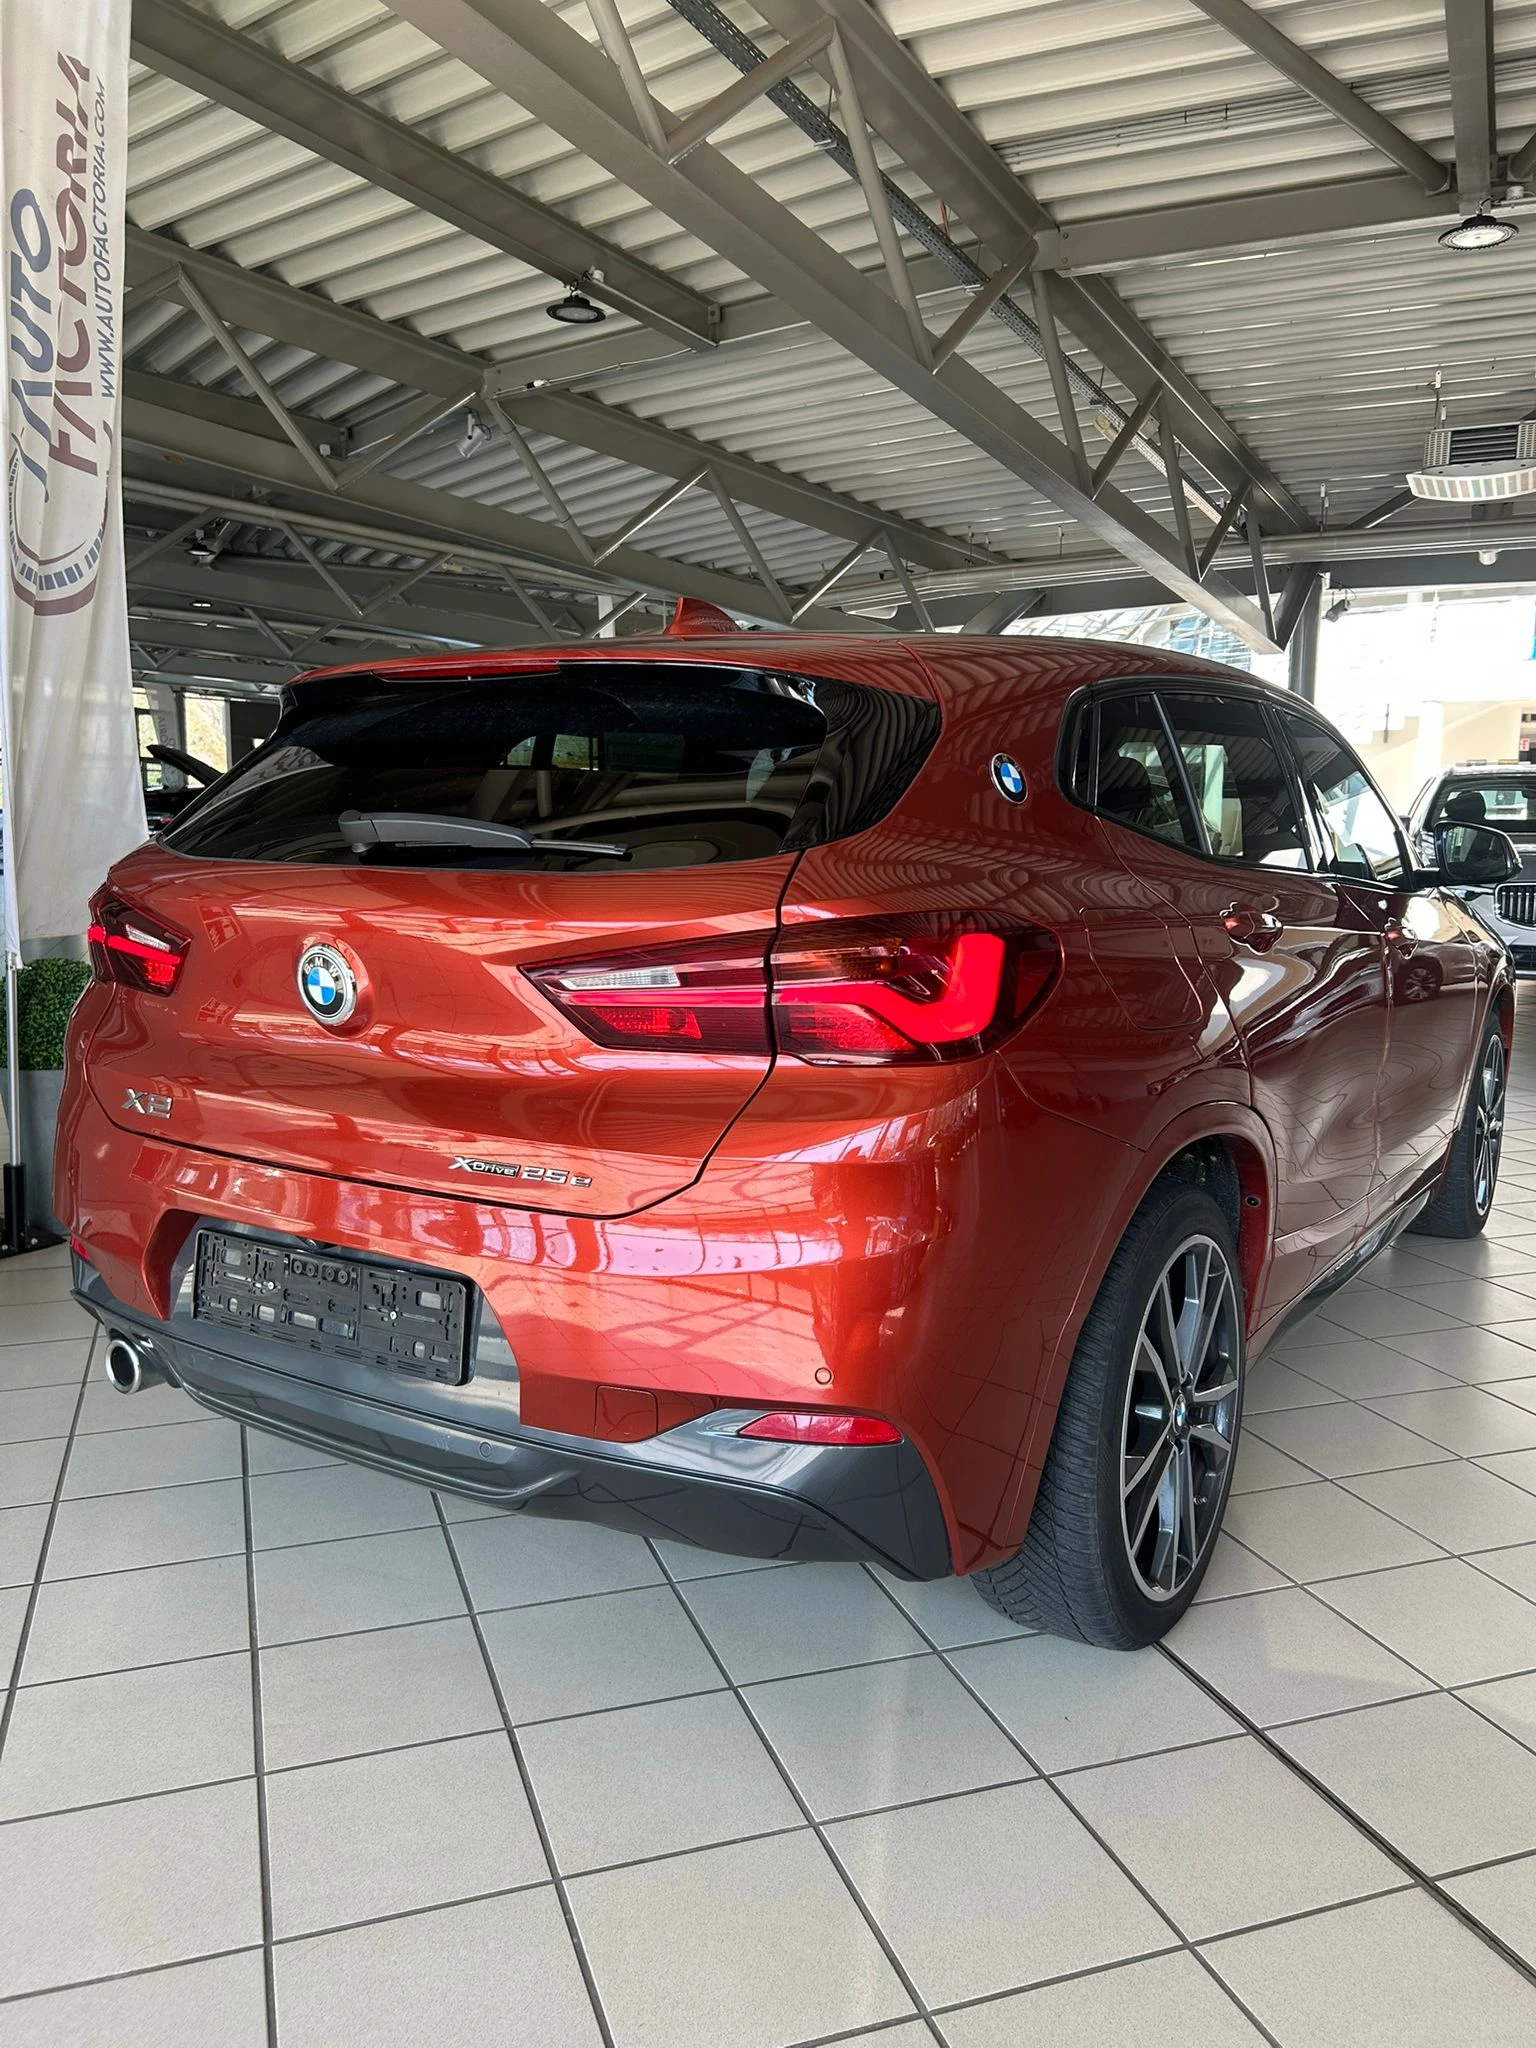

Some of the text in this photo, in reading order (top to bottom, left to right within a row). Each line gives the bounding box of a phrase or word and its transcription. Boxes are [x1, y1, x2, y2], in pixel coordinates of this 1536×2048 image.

[10, 188, 54, 444] AUTO
[49, 51, 97, 477] FACTORIA
[91, 74, 115, 399] WWW.AUTOFACTORIA.COM
[303, 956, 340, 978] BMW
[121, 1088, 173, 1119] X2
